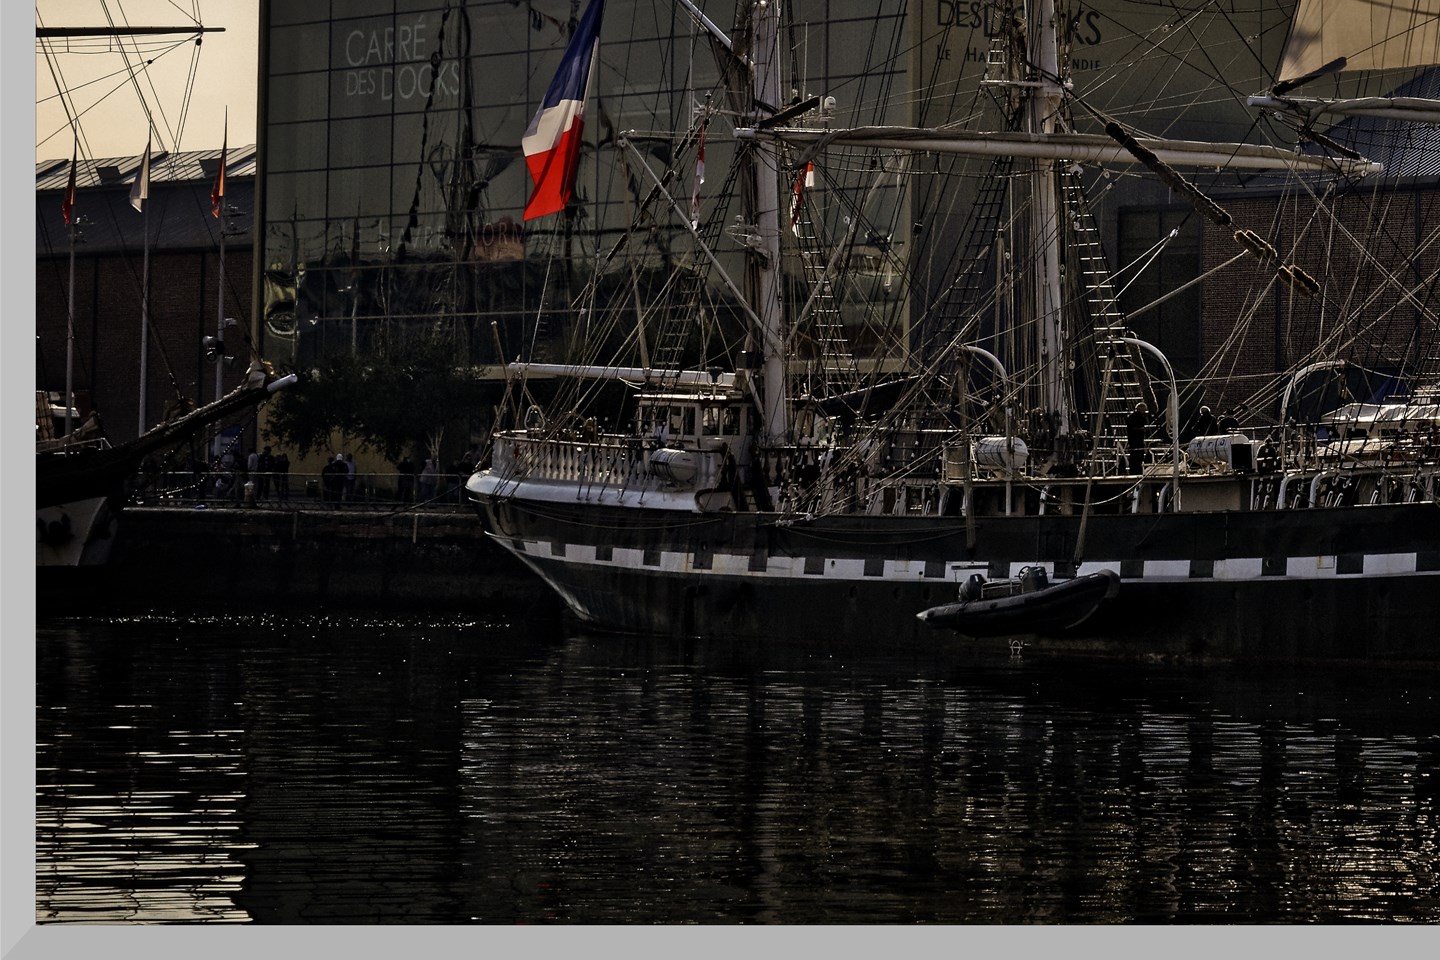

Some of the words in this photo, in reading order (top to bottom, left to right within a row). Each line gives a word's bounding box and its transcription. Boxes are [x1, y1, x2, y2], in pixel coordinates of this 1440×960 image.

[346, 15, 426, 66] CARRÉ
[937, 0, 982, 29] DES
[984, 3, 1102, 46] DKS
[346, 69, 376, 96] DES
[381, 62, 460, 100] DOCKS
